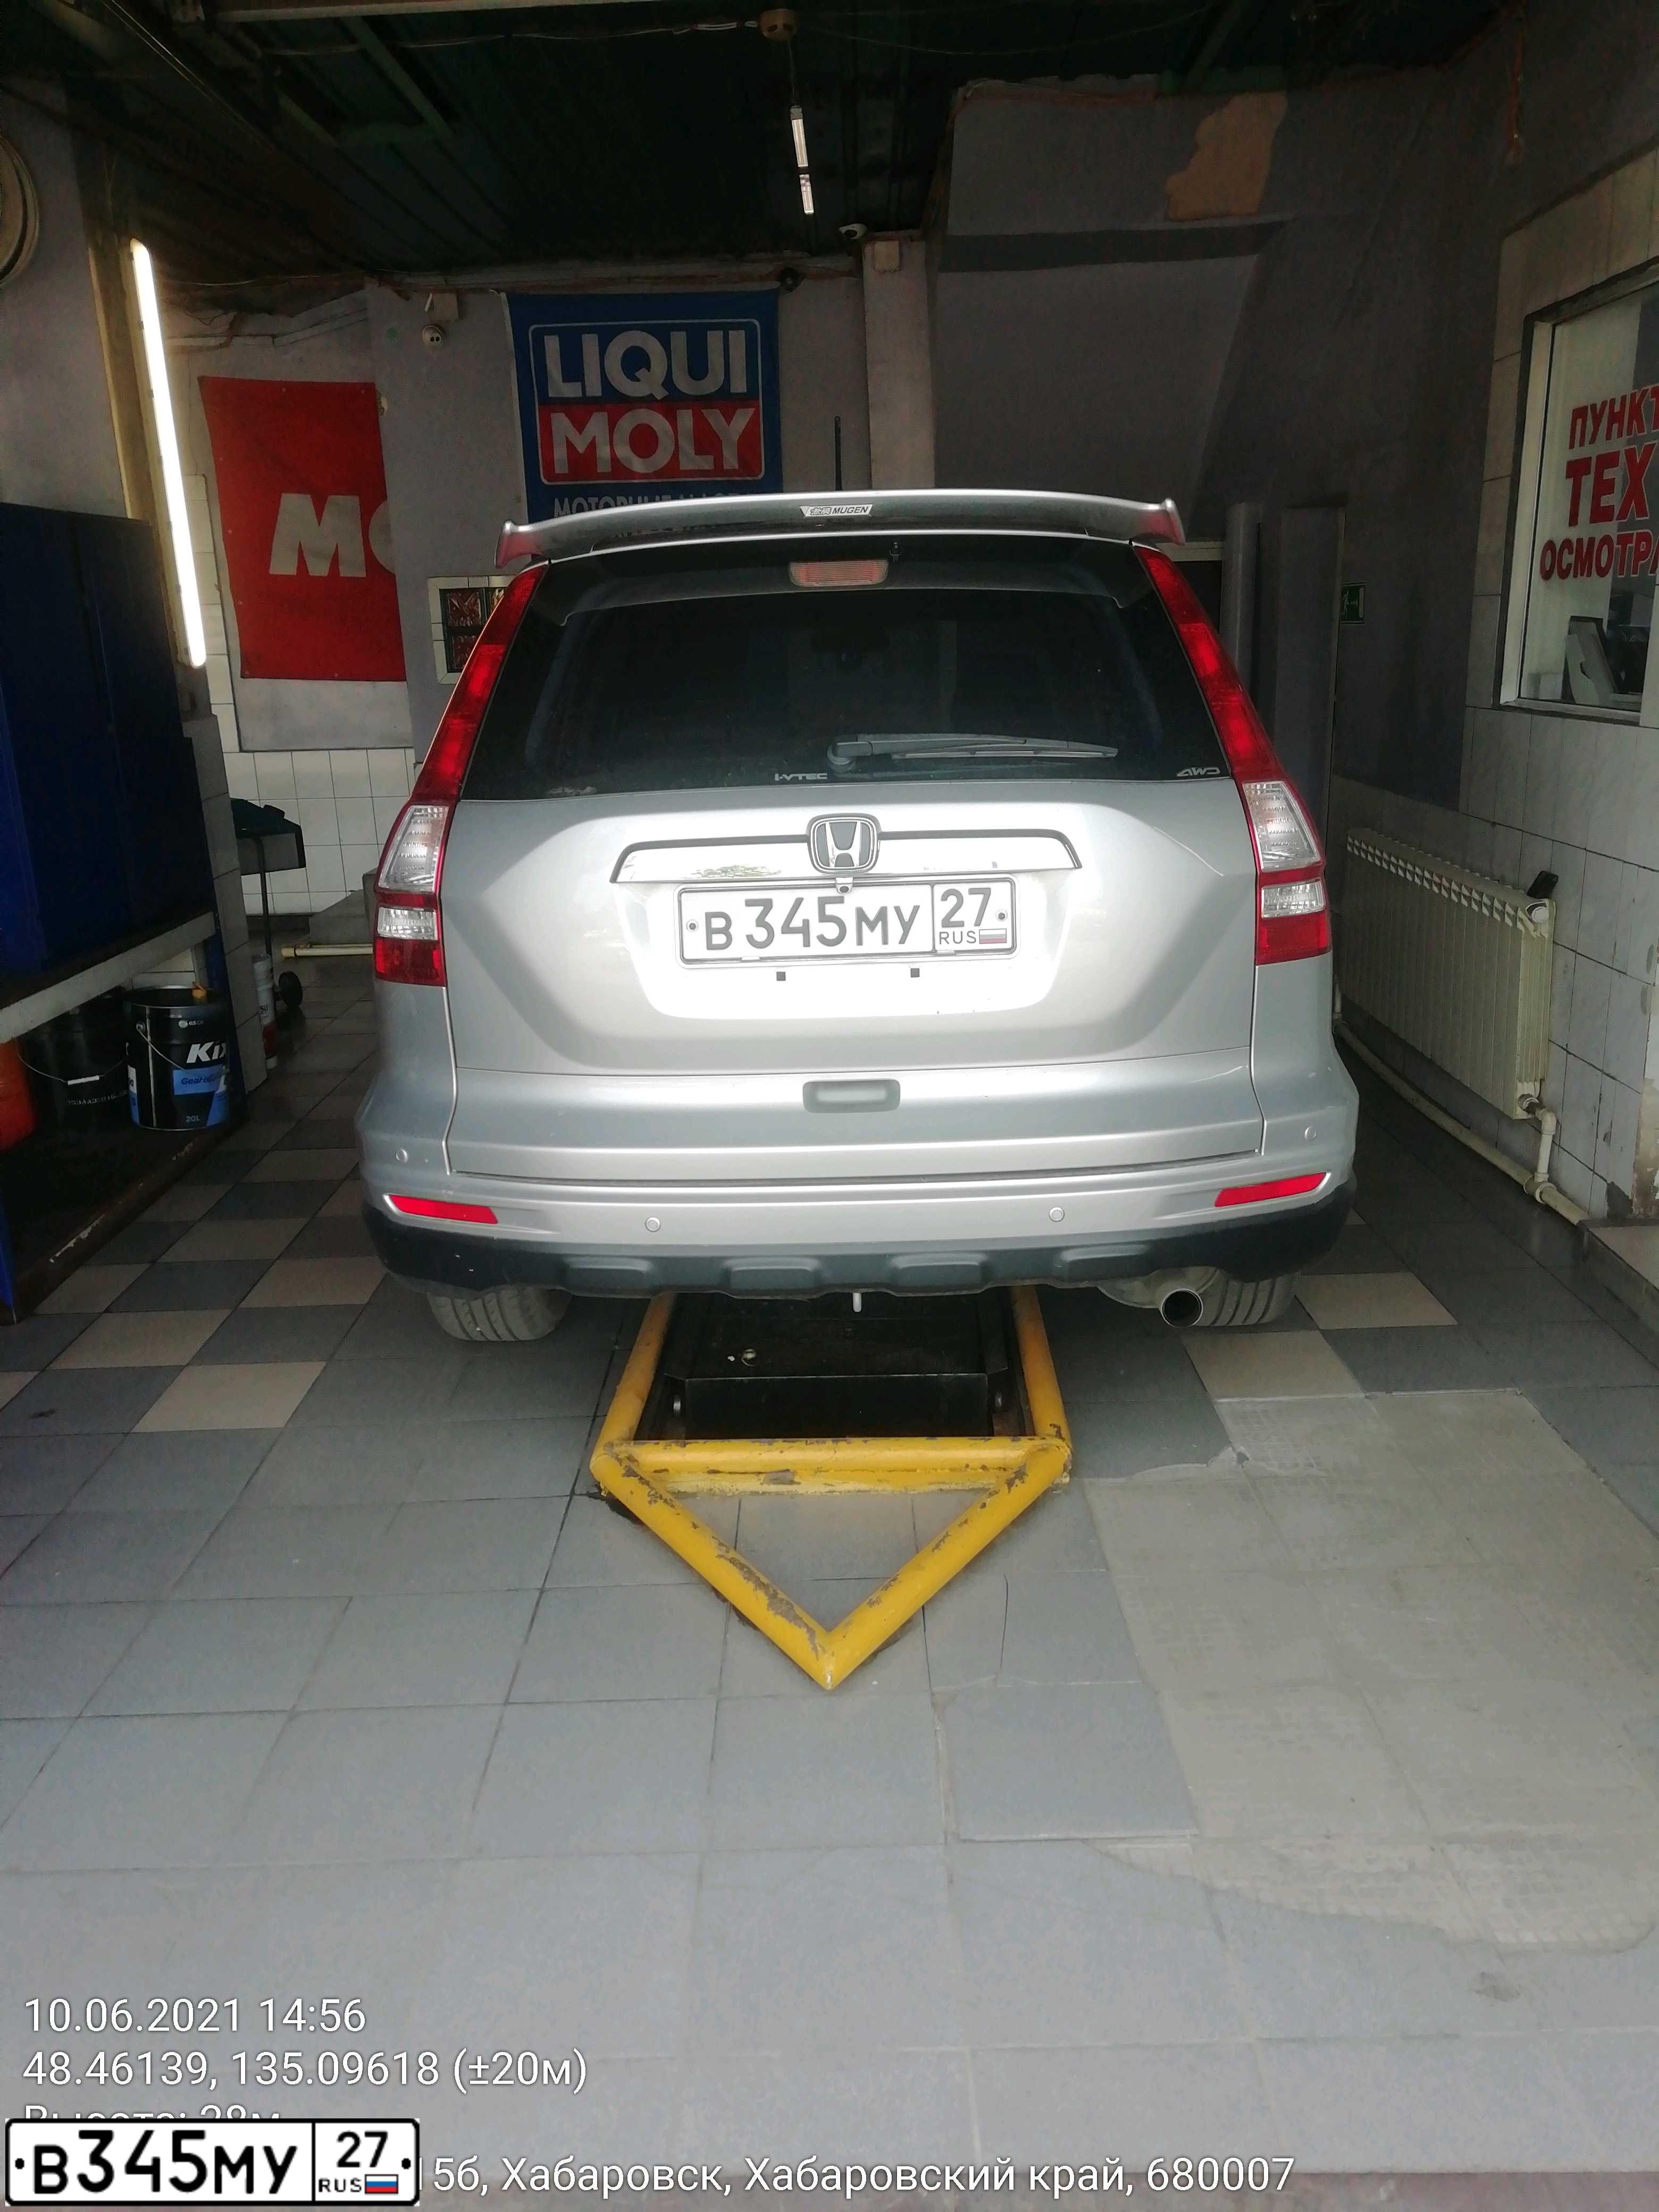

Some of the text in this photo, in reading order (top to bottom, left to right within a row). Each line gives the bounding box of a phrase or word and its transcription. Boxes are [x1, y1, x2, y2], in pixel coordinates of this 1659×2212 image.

[543, 330, 747, 400] LIQUI
[550, 407, 756, 474] MOLY
[832, 506, 869, 515] MUGEN
[1565, 442, 1656, 527] ТЕХ
[705, 887, 992, 951] В345МУ 27
[939, 930, 977, 945] RUS
